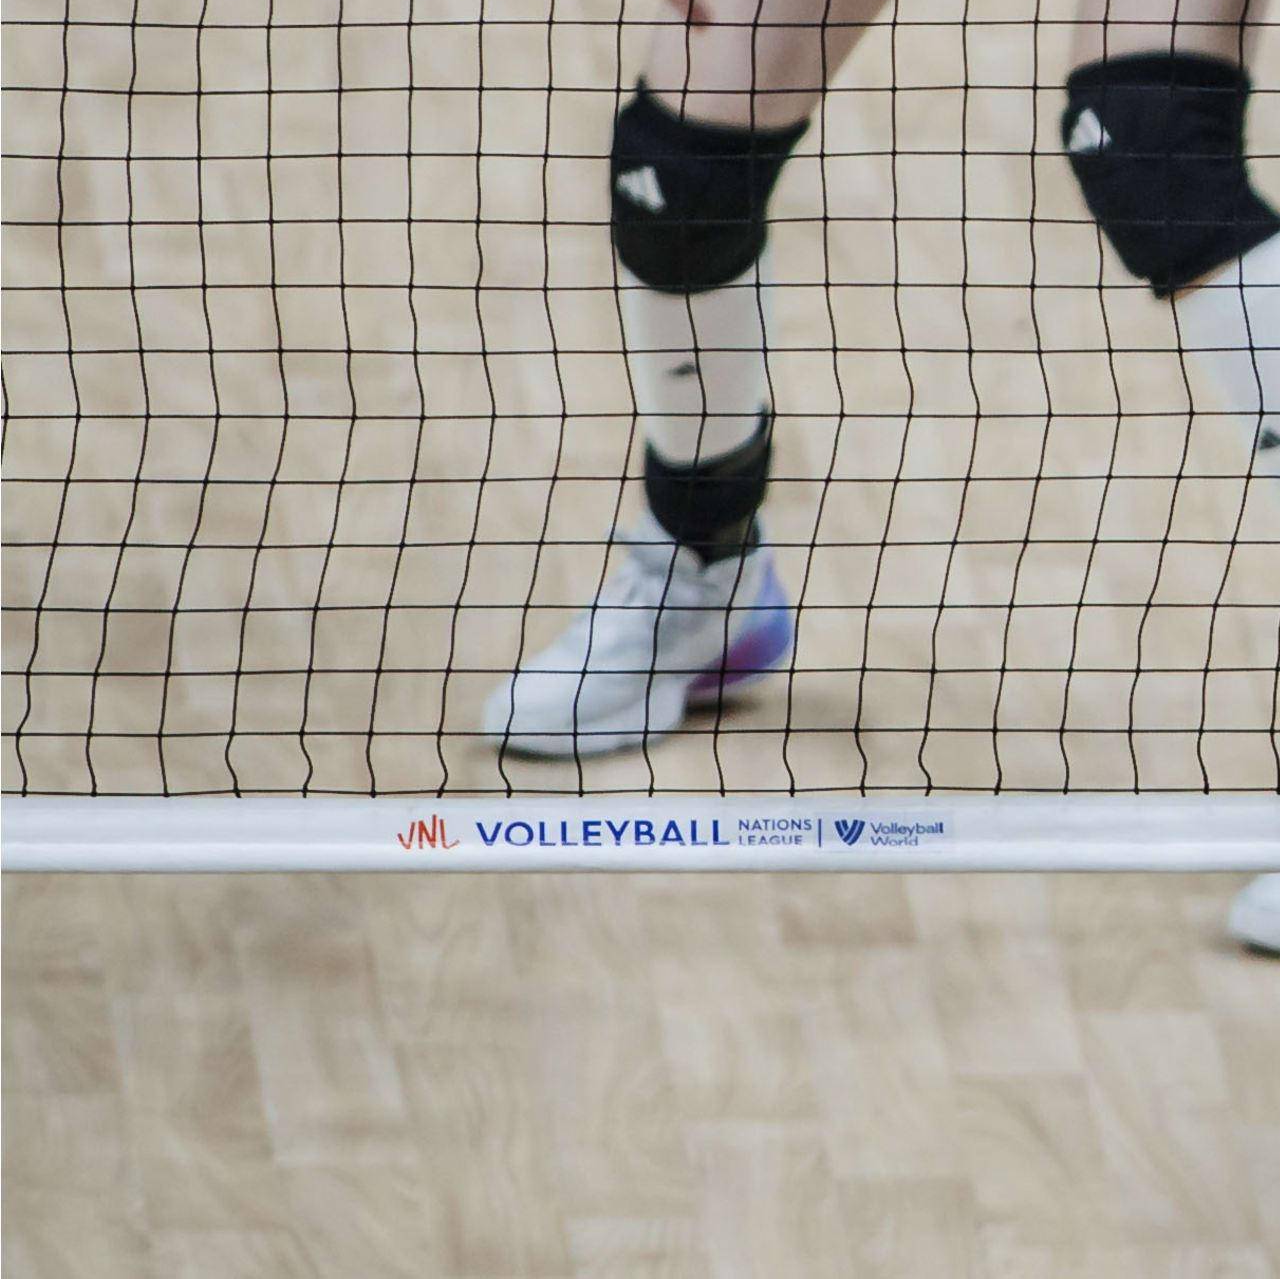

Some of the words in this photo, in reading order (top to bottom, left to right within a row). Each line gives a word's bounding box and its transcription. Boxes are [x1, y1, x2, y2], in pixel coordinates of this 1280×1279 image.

[397, 814, 460, 849] VNL
[476, 820, 731, 847] VOLLEYBALL
[738, 818, 813, 831] NATIONS
[870, 821, 944, 837] Volleyball
[738, 834, 803, 846] LEAGUE
[870, 835, 919, 847] World
